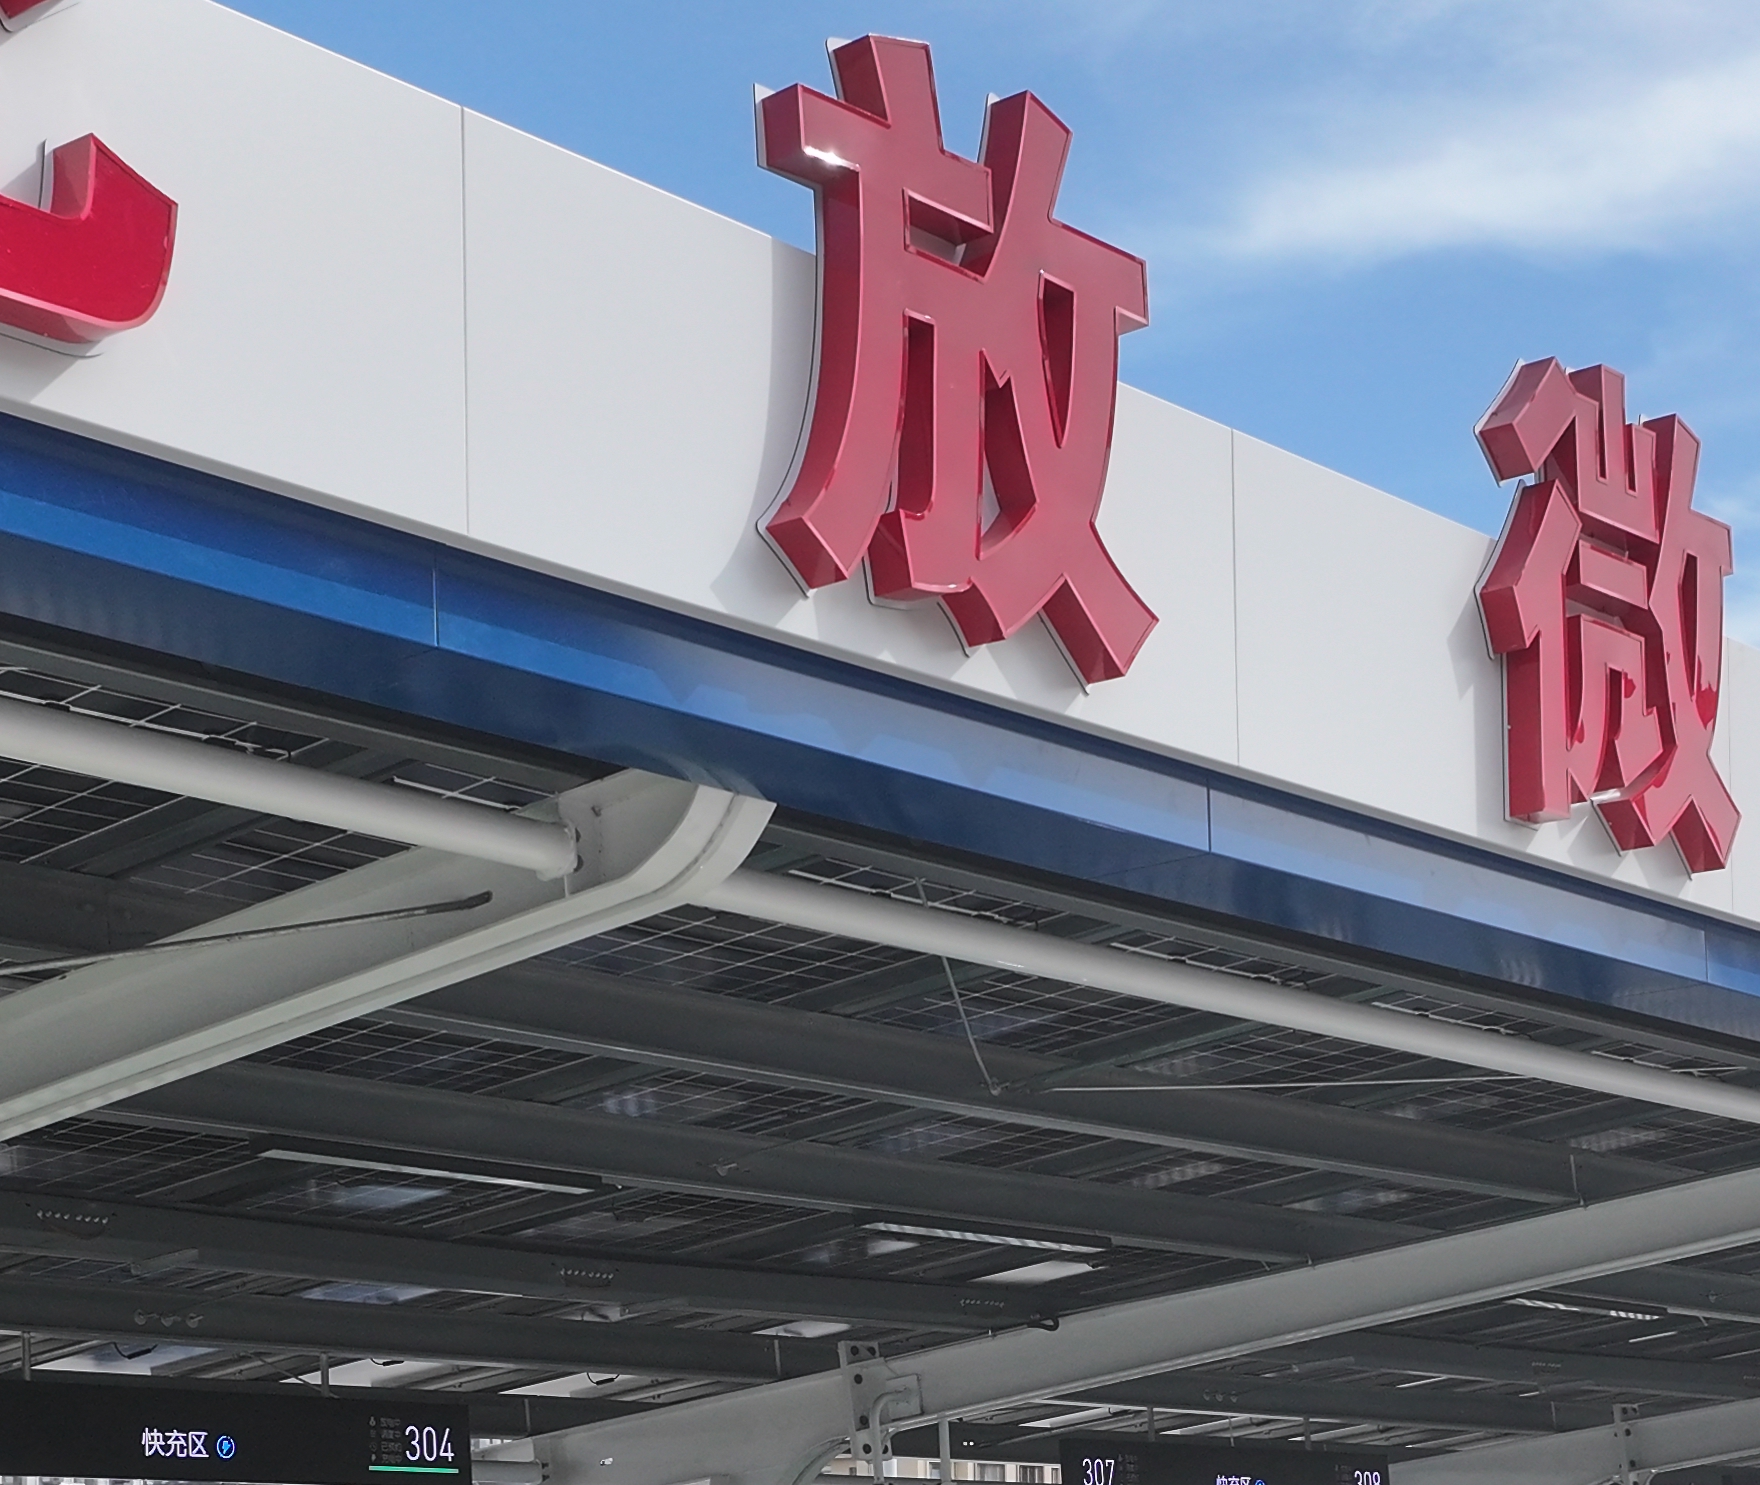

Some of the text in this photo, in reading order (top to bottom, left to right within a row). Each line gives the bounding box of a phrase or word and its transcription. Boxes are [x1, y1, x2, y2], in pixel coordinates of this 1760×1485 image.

[141, 1427, 209, 1459] 快充区
[404, 1425, 455, 1463] 304
